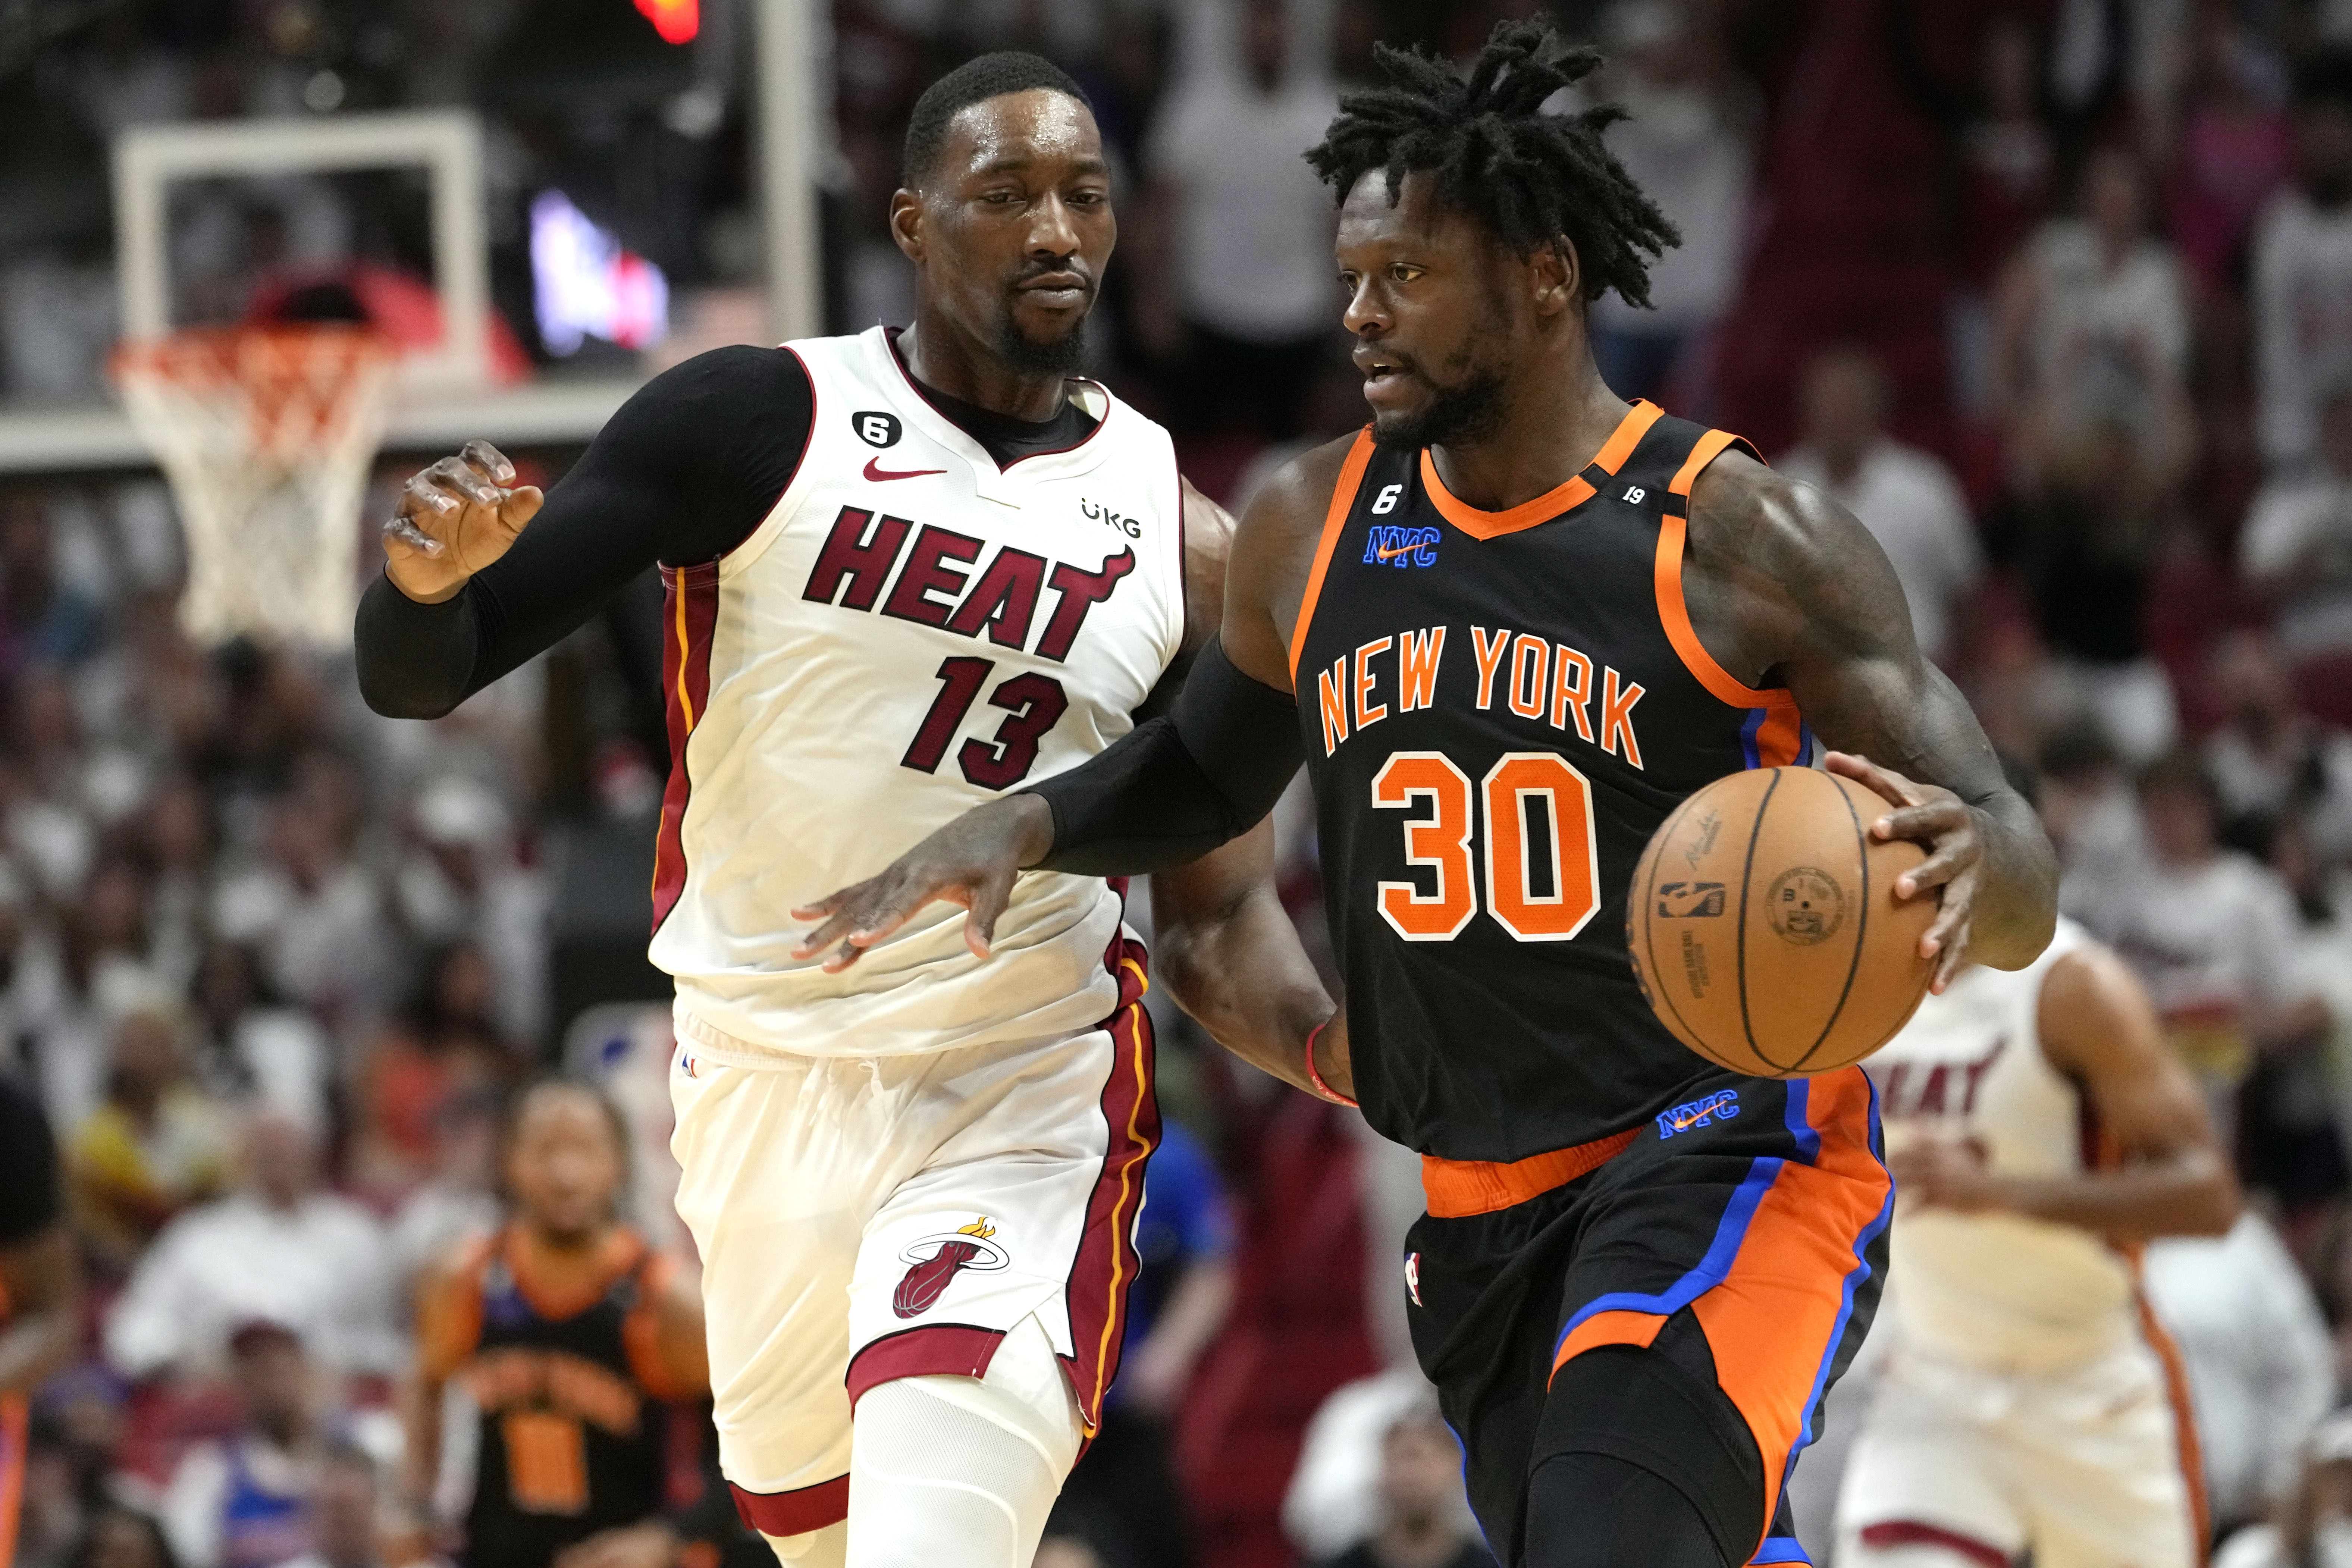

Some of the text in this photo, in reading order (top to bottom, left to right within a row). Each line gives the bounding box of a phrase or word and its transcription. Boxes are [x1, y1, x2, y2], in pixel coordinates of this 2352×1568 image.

[863, 416, 890, 444] 6
[1371, 484, 1403, 514] 6
[1622, 486, 1645, 504] 19
[1362, 525, 1442, 568] NYC
[802, 505, 1136, 663] HEAT
[1318, 624, 1646, 771] NEW YORK
[900, 656, 1069, 791] 13
[1371, 751, 1602, 942] 30
[1655, 1089, 1741, 1140] NYC
